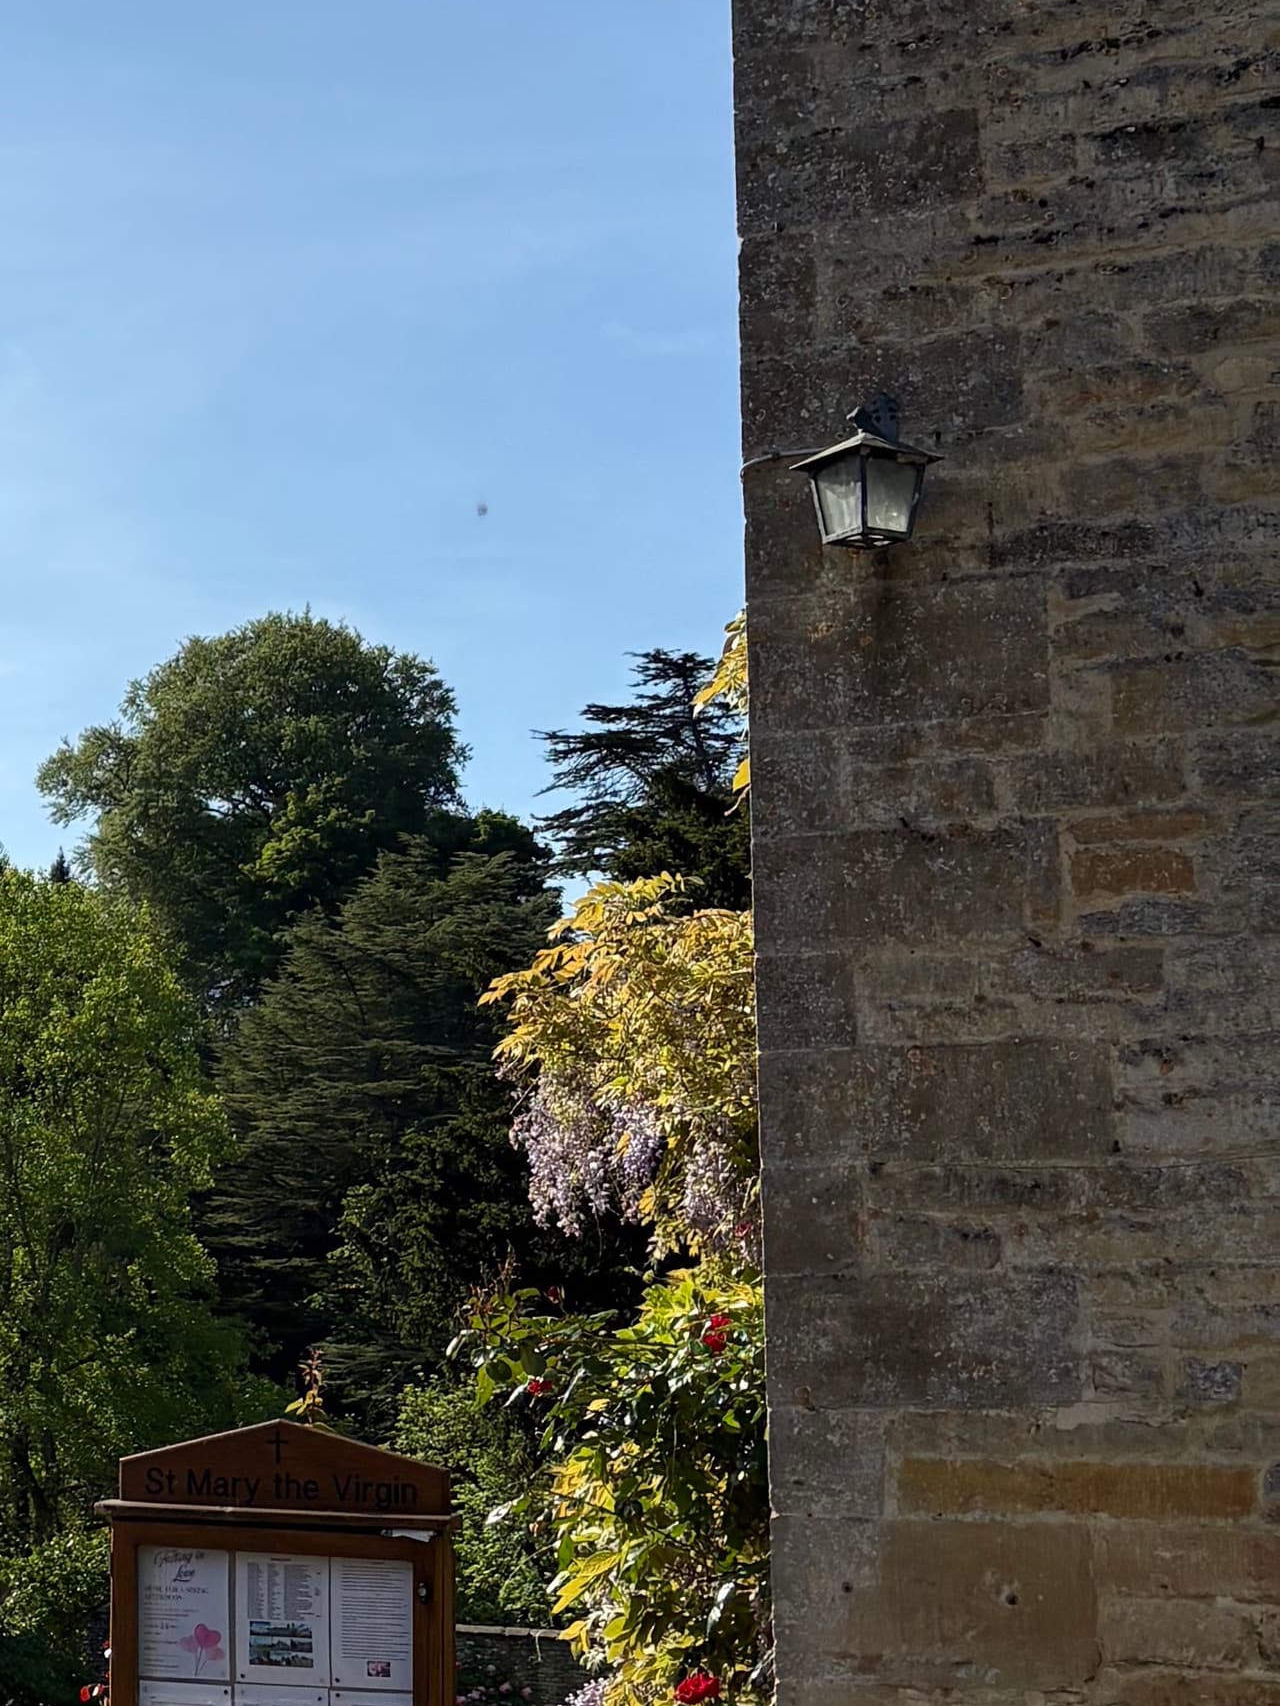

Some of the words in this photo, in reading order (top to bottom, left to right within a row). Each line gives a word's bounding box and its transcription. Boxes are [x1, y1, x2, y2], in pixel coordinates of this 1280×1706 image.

[145, 1466, 176, 1496] St
[187, 1469, 261, 1505] Mary
[273, 1472, 319, 1501] the
[332, 1474, 419, 1509] Virgin
